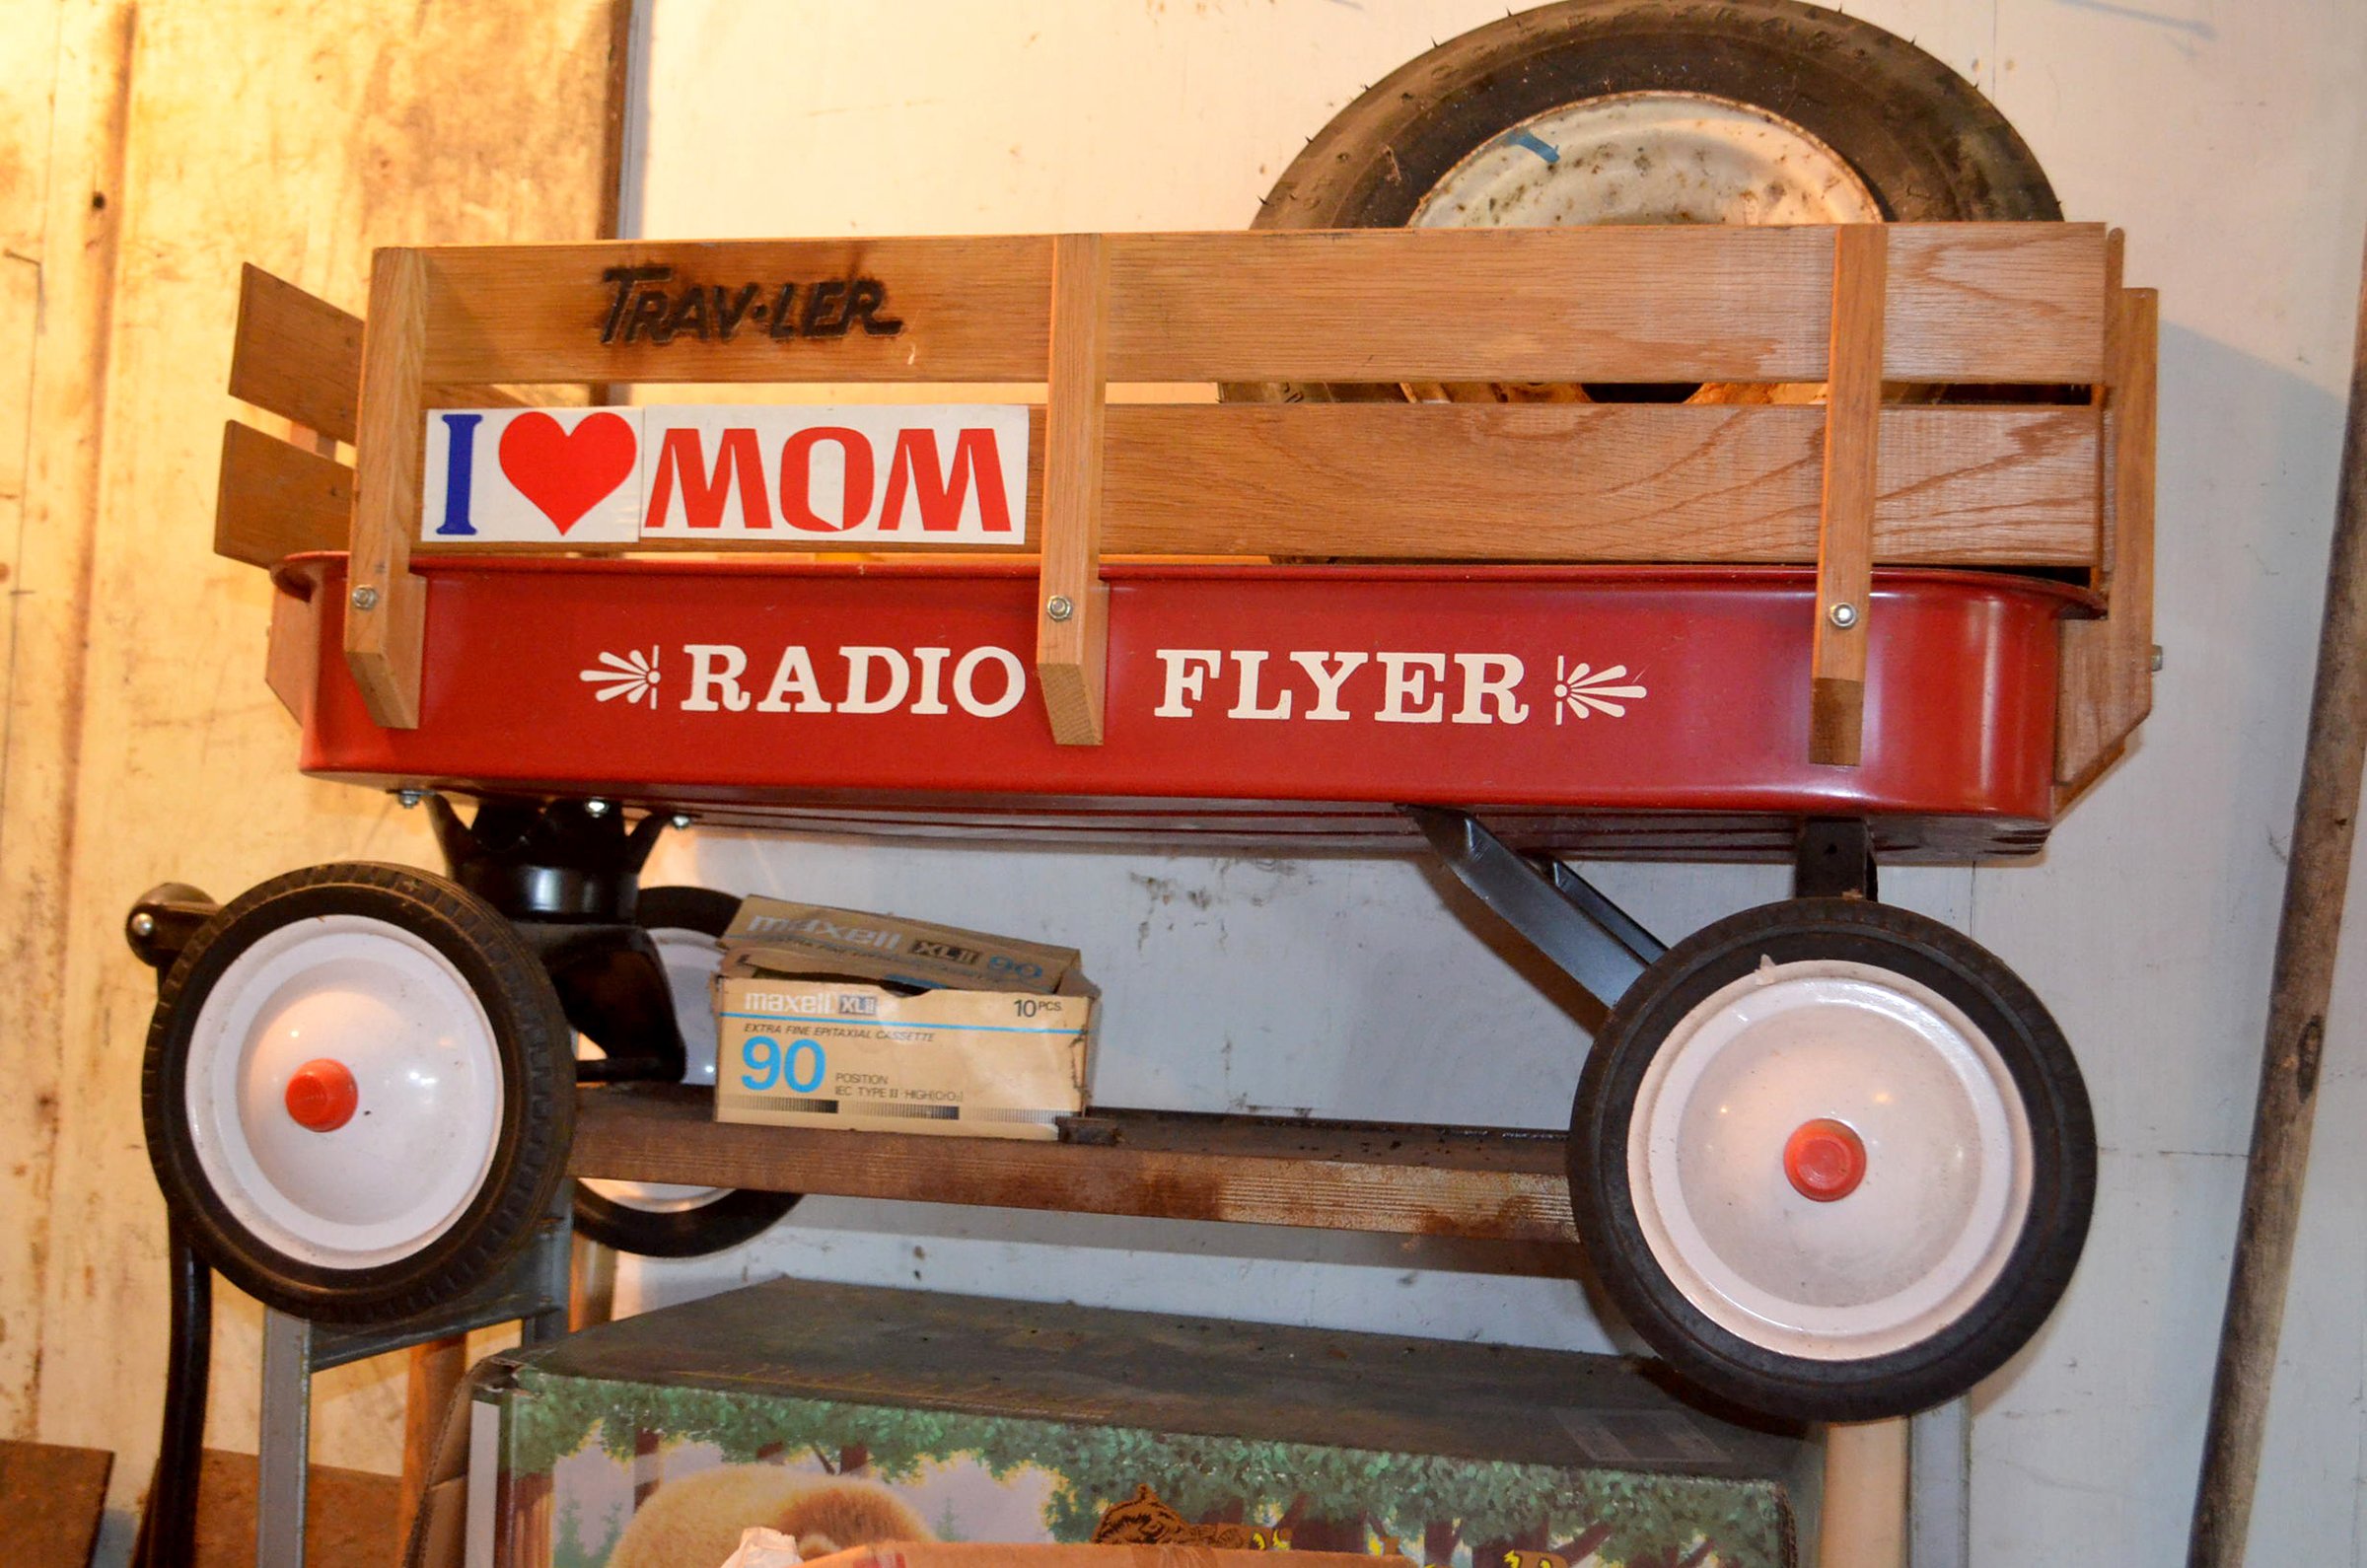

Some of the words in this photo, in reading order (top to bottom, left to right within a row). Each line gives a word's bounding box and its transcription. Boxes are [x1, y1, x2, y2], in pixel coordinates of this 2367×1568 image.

[435, 413, 483, 535] I
[644, 426, 1013, 533] MOM
[681, 643, 1027, 718] RADIO
[1153, 648, 1530, 725] FLYER
[747, 912, 902, 951] maxell
[988, 954, 1043, 979] 90
[744, 992, 834, 1015] maxell
[744, 1023, 782, 1034] EXTRA
[786, 1025, 810, 1036] FINE
[814, 1027, 872, 1039] EPITAXIAL
[875, 1030, 936, 1043] CASSETTE
[741, 1035, 826, 1094] 90
[835, 1072, 889, 1085] POSITION
[834, 1086, 853, 1097] IEC
[857, 1087, 887, 1099] TYPE
